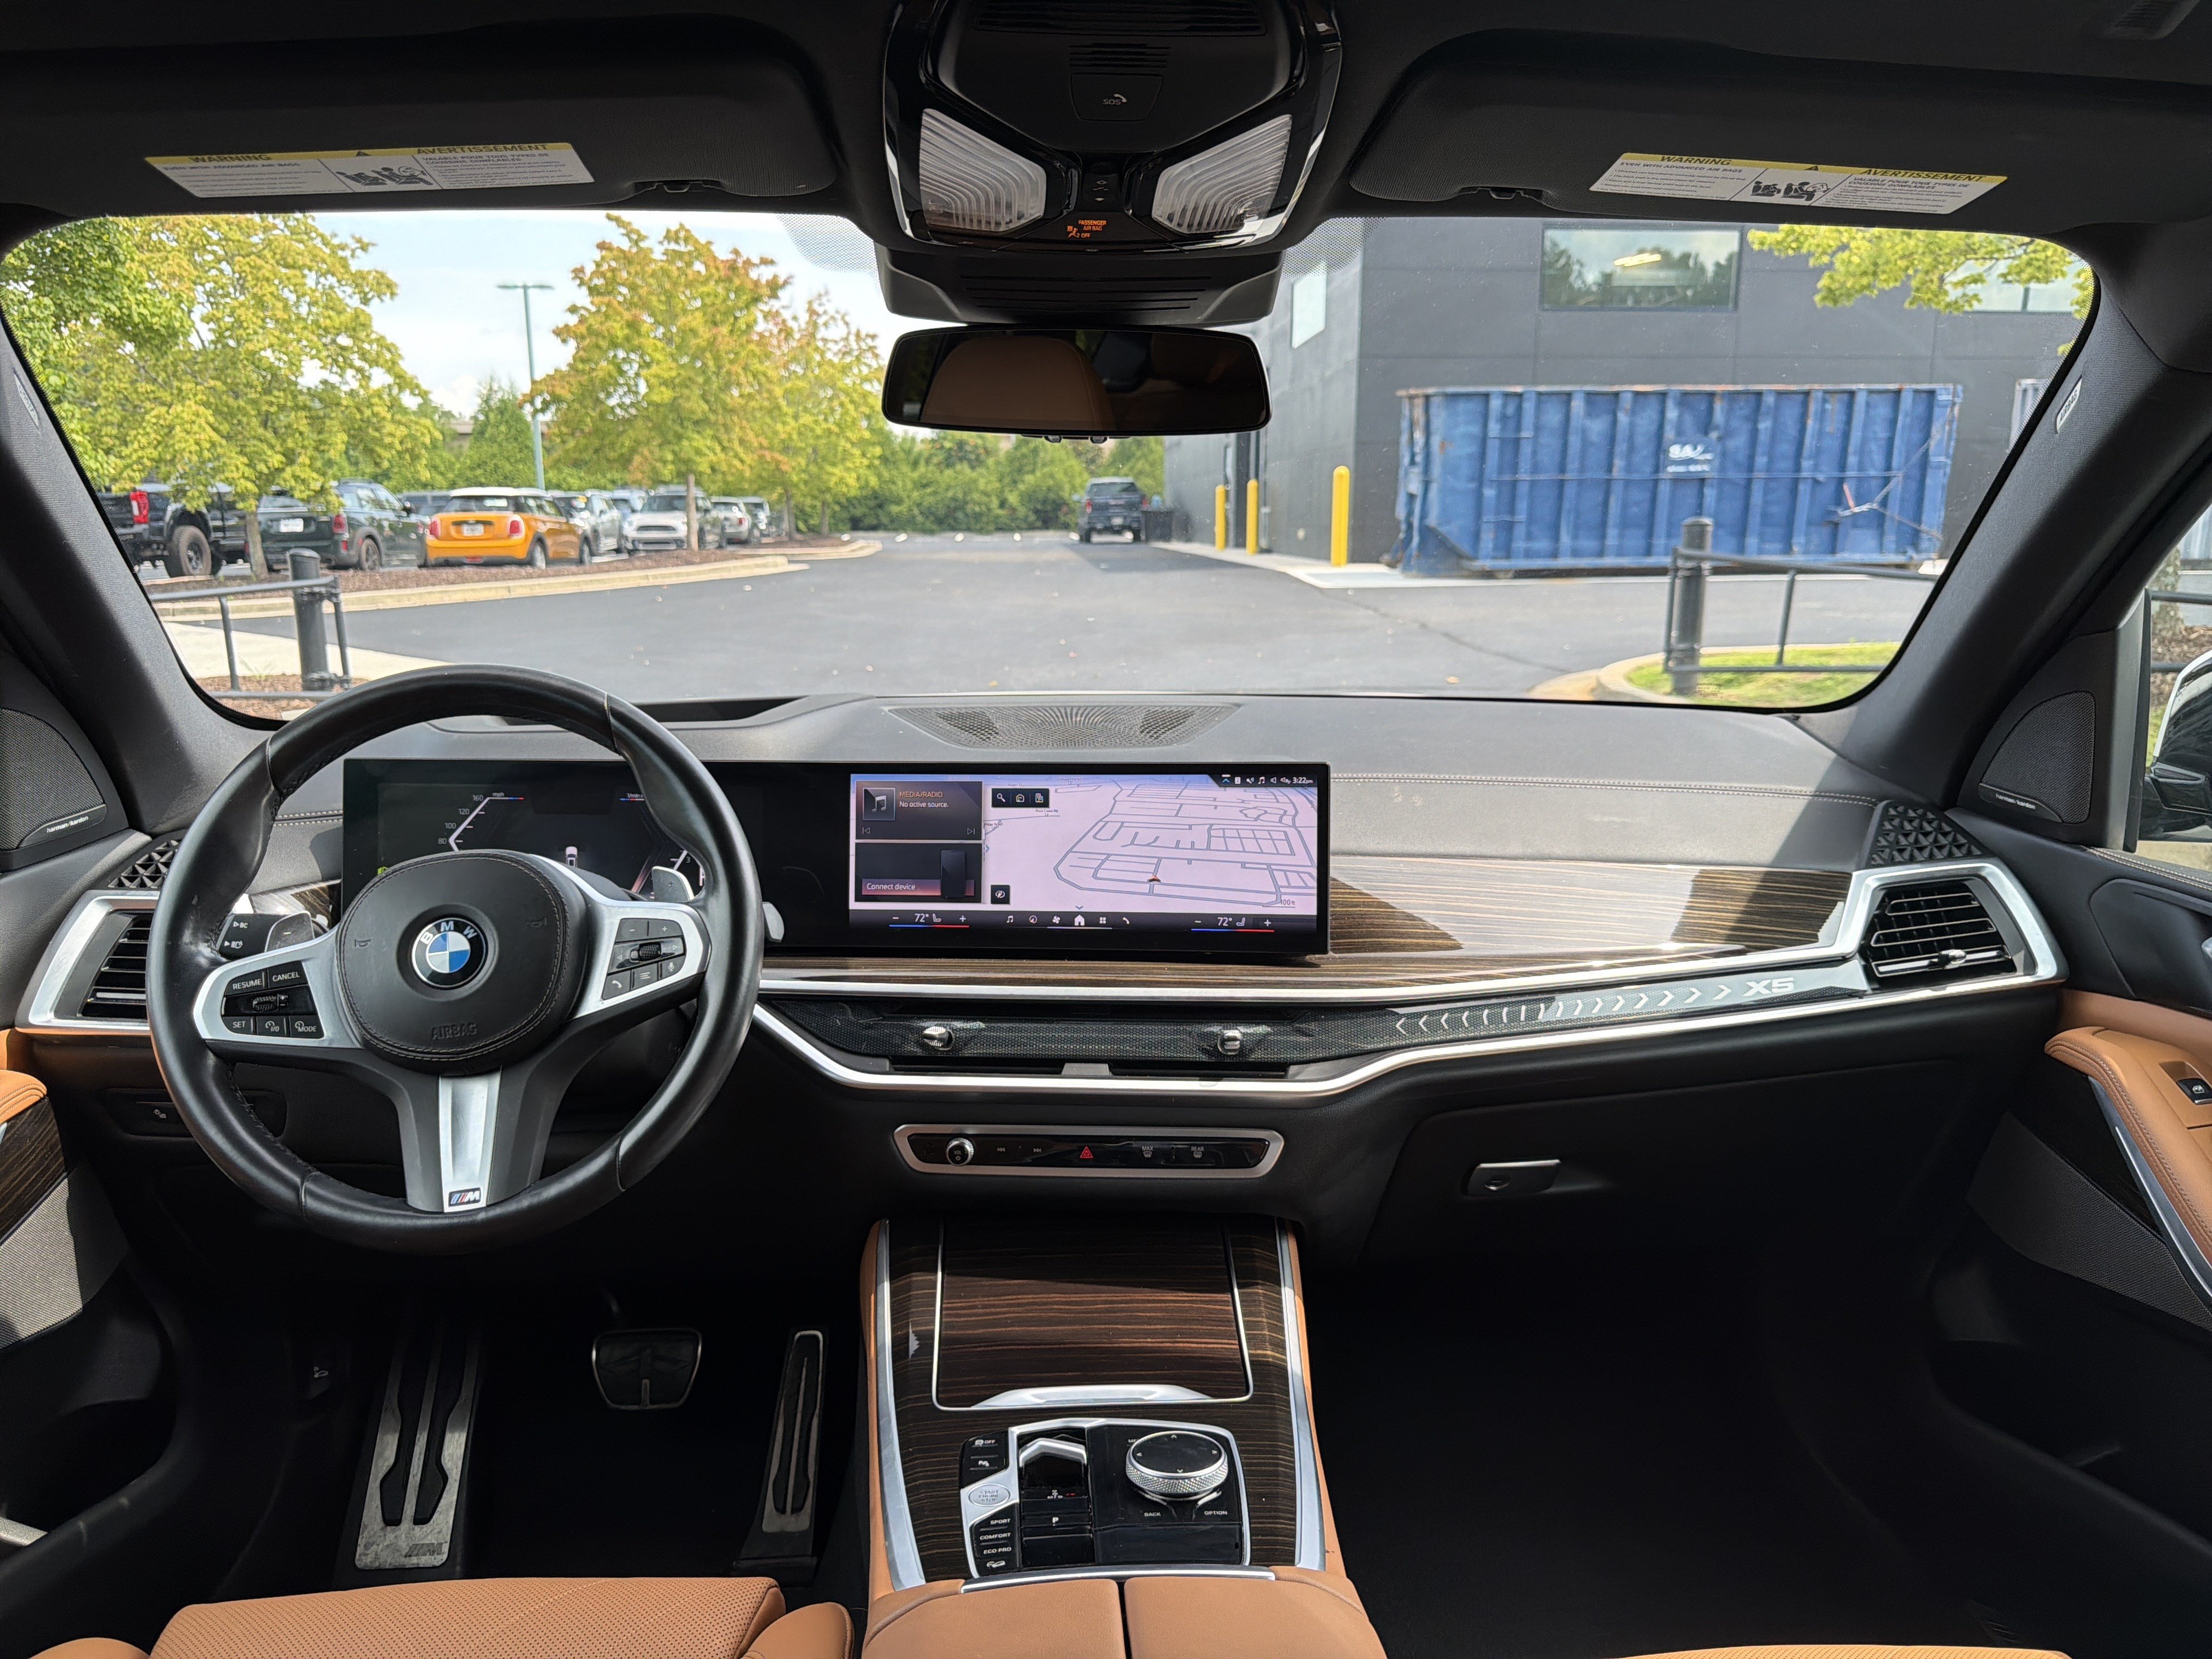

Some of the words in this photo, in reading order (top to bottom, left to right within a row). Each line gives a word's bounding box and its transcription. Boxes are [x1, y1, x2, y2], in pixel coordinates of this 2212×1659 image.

[417, 144, 548, 155] AVERTISSEMENT
[189, 154, 272, 163] WARNING
[1660, 156, 1733, 165] WARNING
[1860, 169, 1988, 182] AVERTISSEMENT
[1995, 793, 2036, 809] harman/kardon
[46, 816, 89, 833] harman/kardon
[420, 921, 477, 944] BMW
[272, 971, 301, 982] CANCEL
[233, 978, 262, 990] RESUME
[1743, 977, 1793, 997] X5
[432, 1022, 477, 1040] AIRBAG
[979, 1532, 1011, 1541] COMFORT
